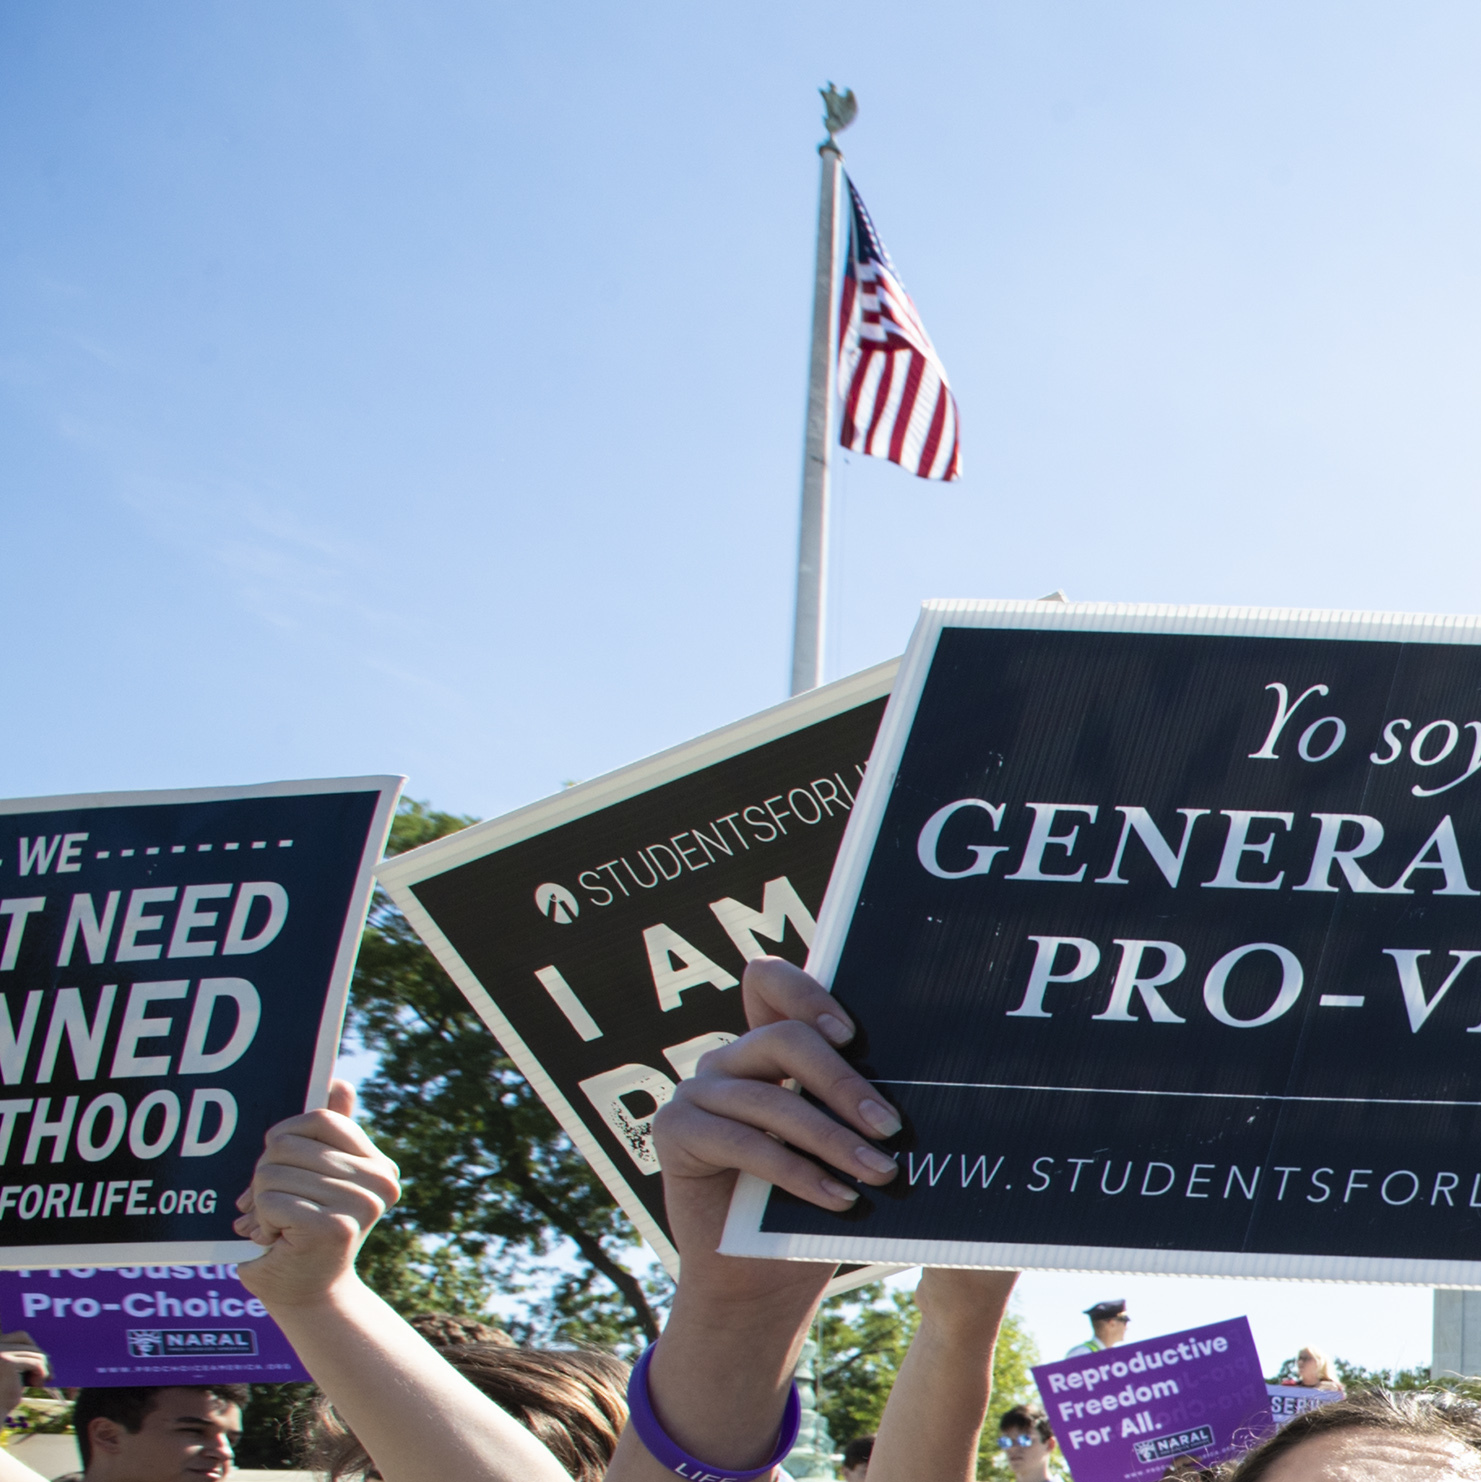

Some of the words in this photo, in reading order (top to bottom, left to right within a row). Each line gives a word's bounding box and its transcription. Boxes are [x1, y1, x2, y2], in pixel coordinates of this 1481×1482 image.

[1247, 681, 1347, 763] Yo
[18, 832, 90, 877] WE
[56, 880, 290, 968] NEED
[533, 963, 604, 1042] I
[642, 875, 818, 1013] AM
[165, 1333, 249, 1347] NARAL
[1047, 1335, 1228, 1394] Reproductive
[1057, 1378, 1179, 1422] Freedom
[1068, 1425, 1112, 1450] For
[1120, 1411, 1163, 1438] All.
[1157, 1429, 1210, 1452] NARAL
